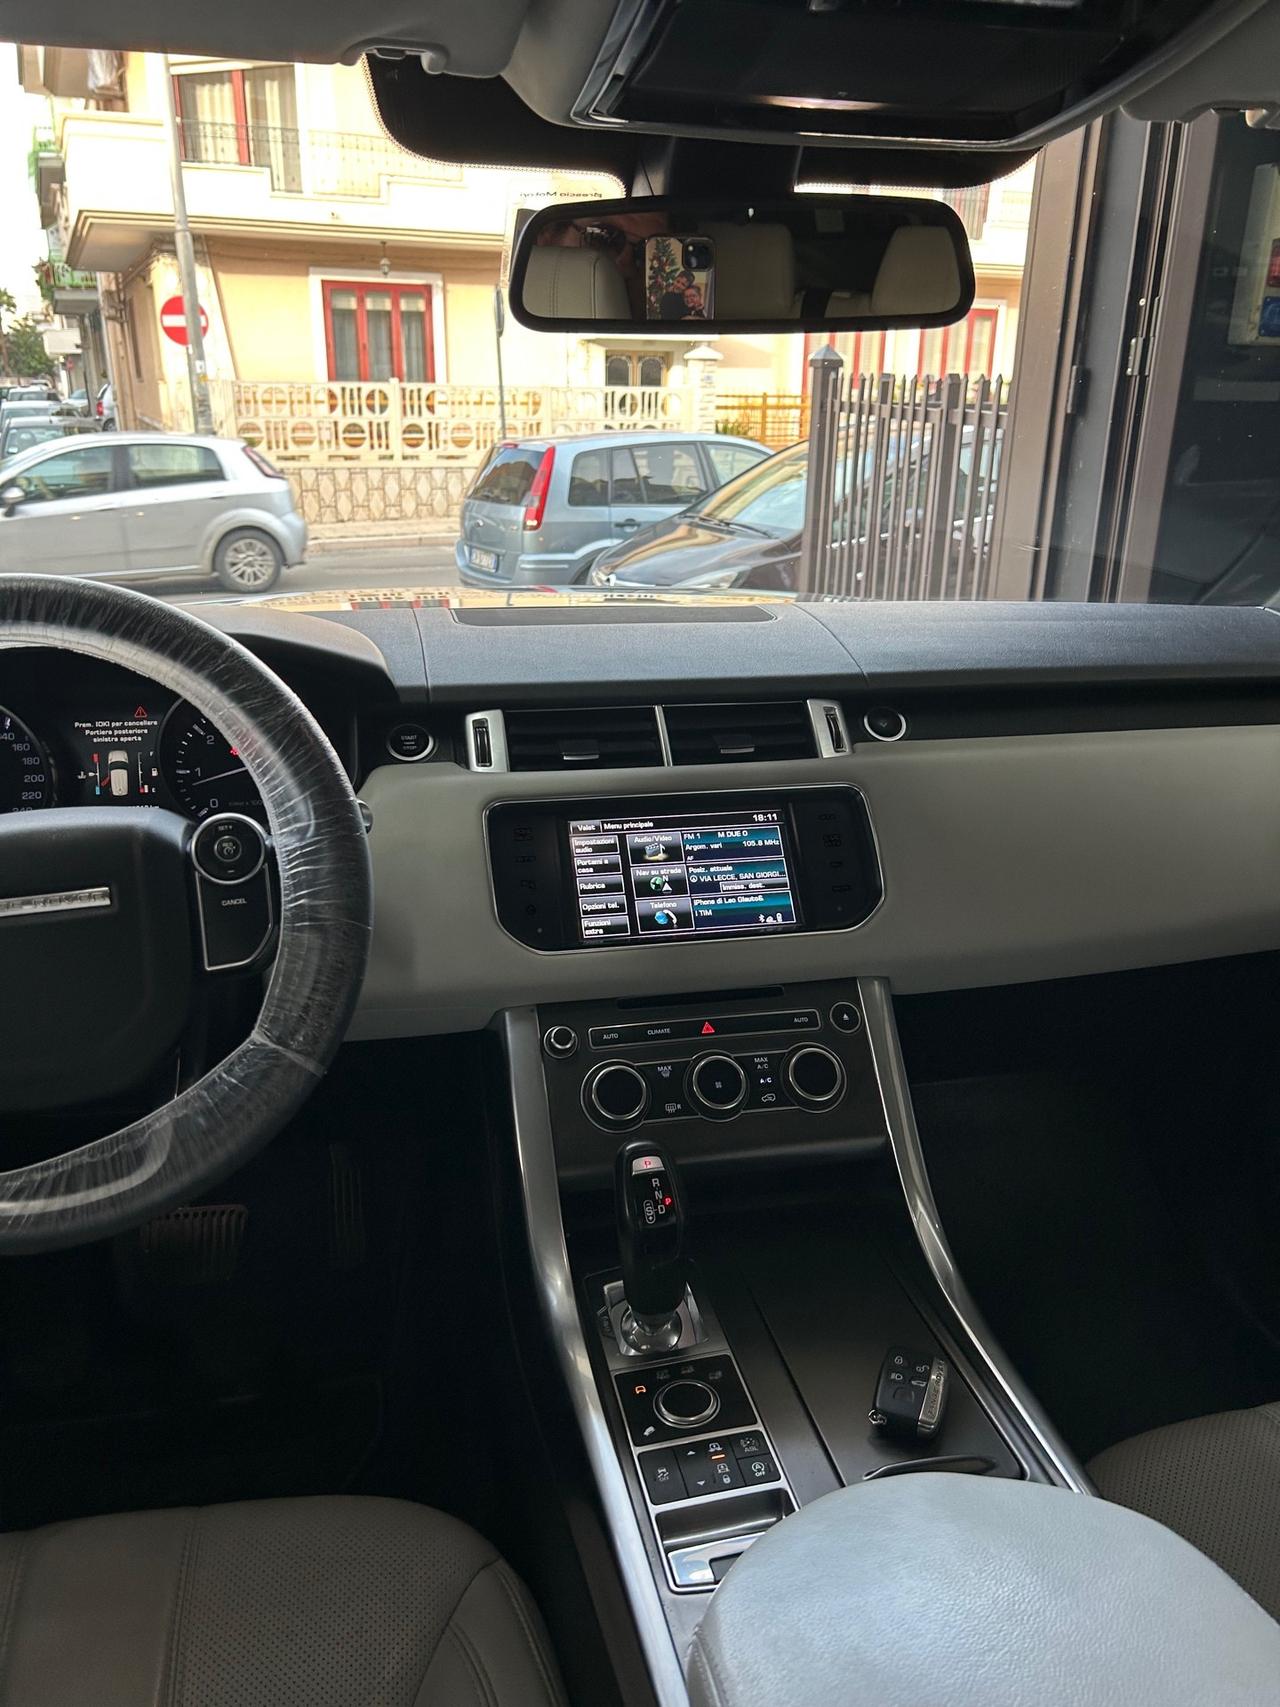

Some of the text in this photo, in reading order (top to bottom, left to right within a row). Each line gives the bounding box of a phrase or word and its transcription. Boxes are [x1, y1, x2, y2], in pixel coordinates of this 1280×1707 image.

[206, 735, 215, 745] 2
[12, 743, 31, 751] 160
[22, 757, 40, 765] 180
[194, 767, 201, 777] 1
[24, 775, 45, 783] 200
[21, 792, 42, 800] 220
[210, 798, 219, 808] 0
[752, 813, 778, 822] 18:11
[577, 824, 596, 832] Valet
[623, 821, 654, 830] principale
[726, 830, 741, 838] DUE
[574, 838, 615, 846] Impostazioni
[634, 835, 673, 843] Audio/Video
[699, 874, 712, 882] VIA
[713, 873, 738, 881] LECCE,
[739, 872, 755, 880] SAN
[582, 903, 607, 911] Opzioni
[649, 901, 677, 909] Telefono
[584, 919, 611, 927] Funzioni
[644, 1160, 652, 1169] P
[651, 1178, 660, 1188] R
[654, 1190, 663, 1200] N
[665, 1197, 672, 1206] P
[657, 1204, 666, 1215] D
